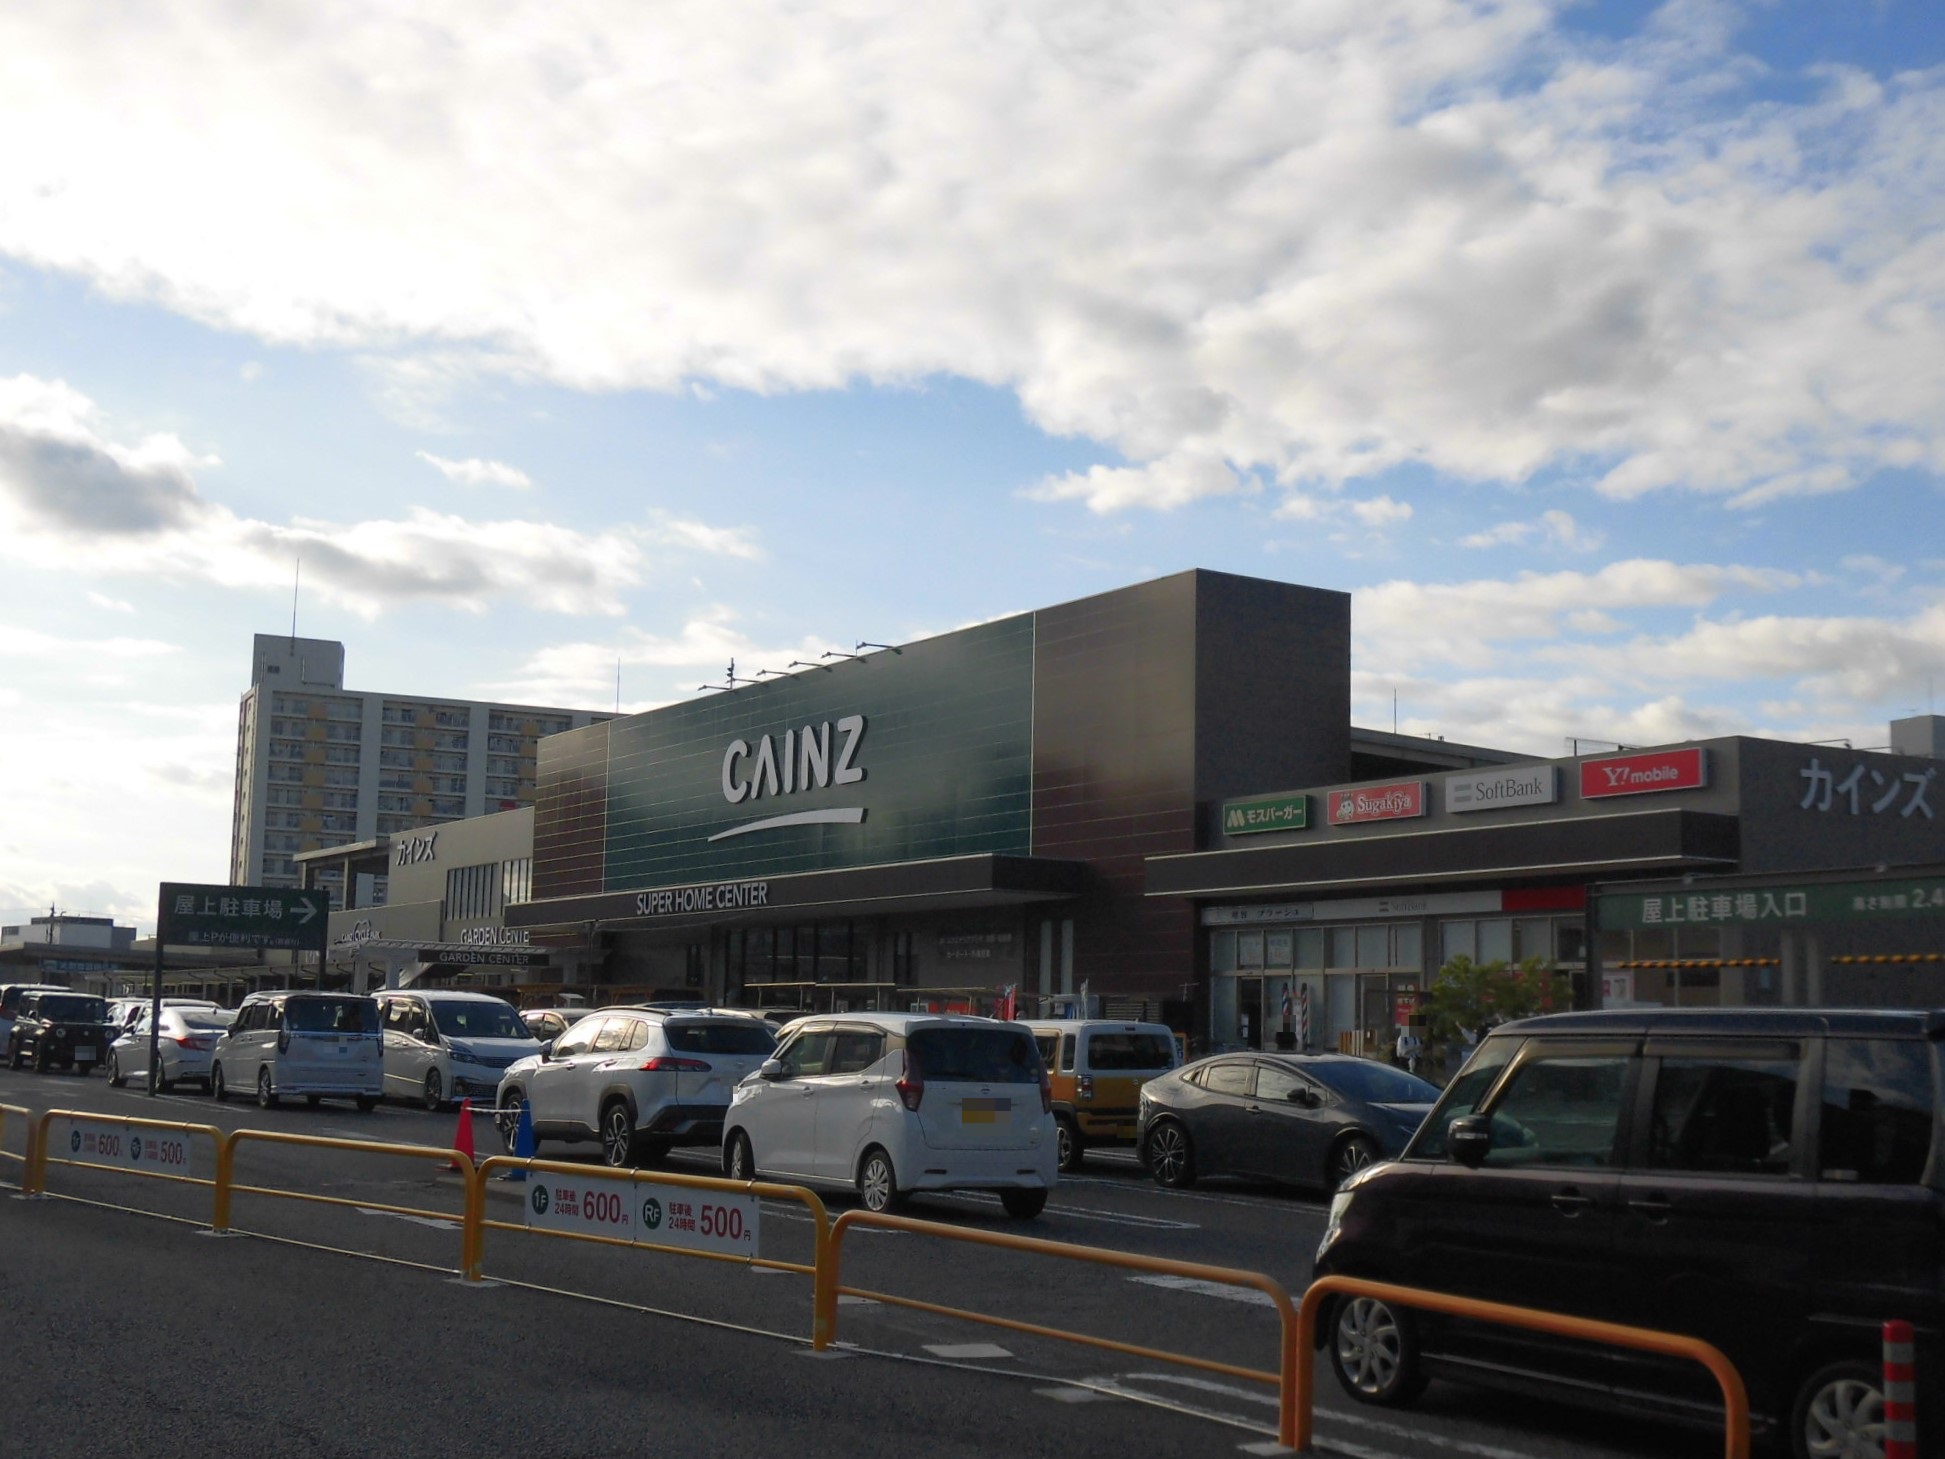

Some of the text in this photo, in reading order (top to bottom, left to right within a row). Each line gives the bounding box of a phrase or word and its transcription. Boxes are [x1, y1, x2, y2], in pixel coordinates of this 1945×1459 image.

[722, 714, 867, 804] CAINZ
[1631, 766, 1678, 784] mobile
[1475, 777, 1542, 802] SoftBank
[1800, 757, 1937, 819] カインズ
[1247, 806, 1303, 824] モスバーガー
[1357, 791, 1413, 815] Sugakiya
[396, 831, 437, 866] カインズ
[174, 895, 283, 920] 屋上駐車場
[636, 881, 767, 915] SUPER HOME CENTER
[1642, 892, 1807, 924] 屋上駐車場入口
[460, 926, 498, 945] GARDEN
[439, 951, 529, 964] GARDEN CENTER
[534, 1190, 546, 1208] 1F
[644, 1205, 660, 1222] RF
[668, 1216, 696, 1232] 24時間
